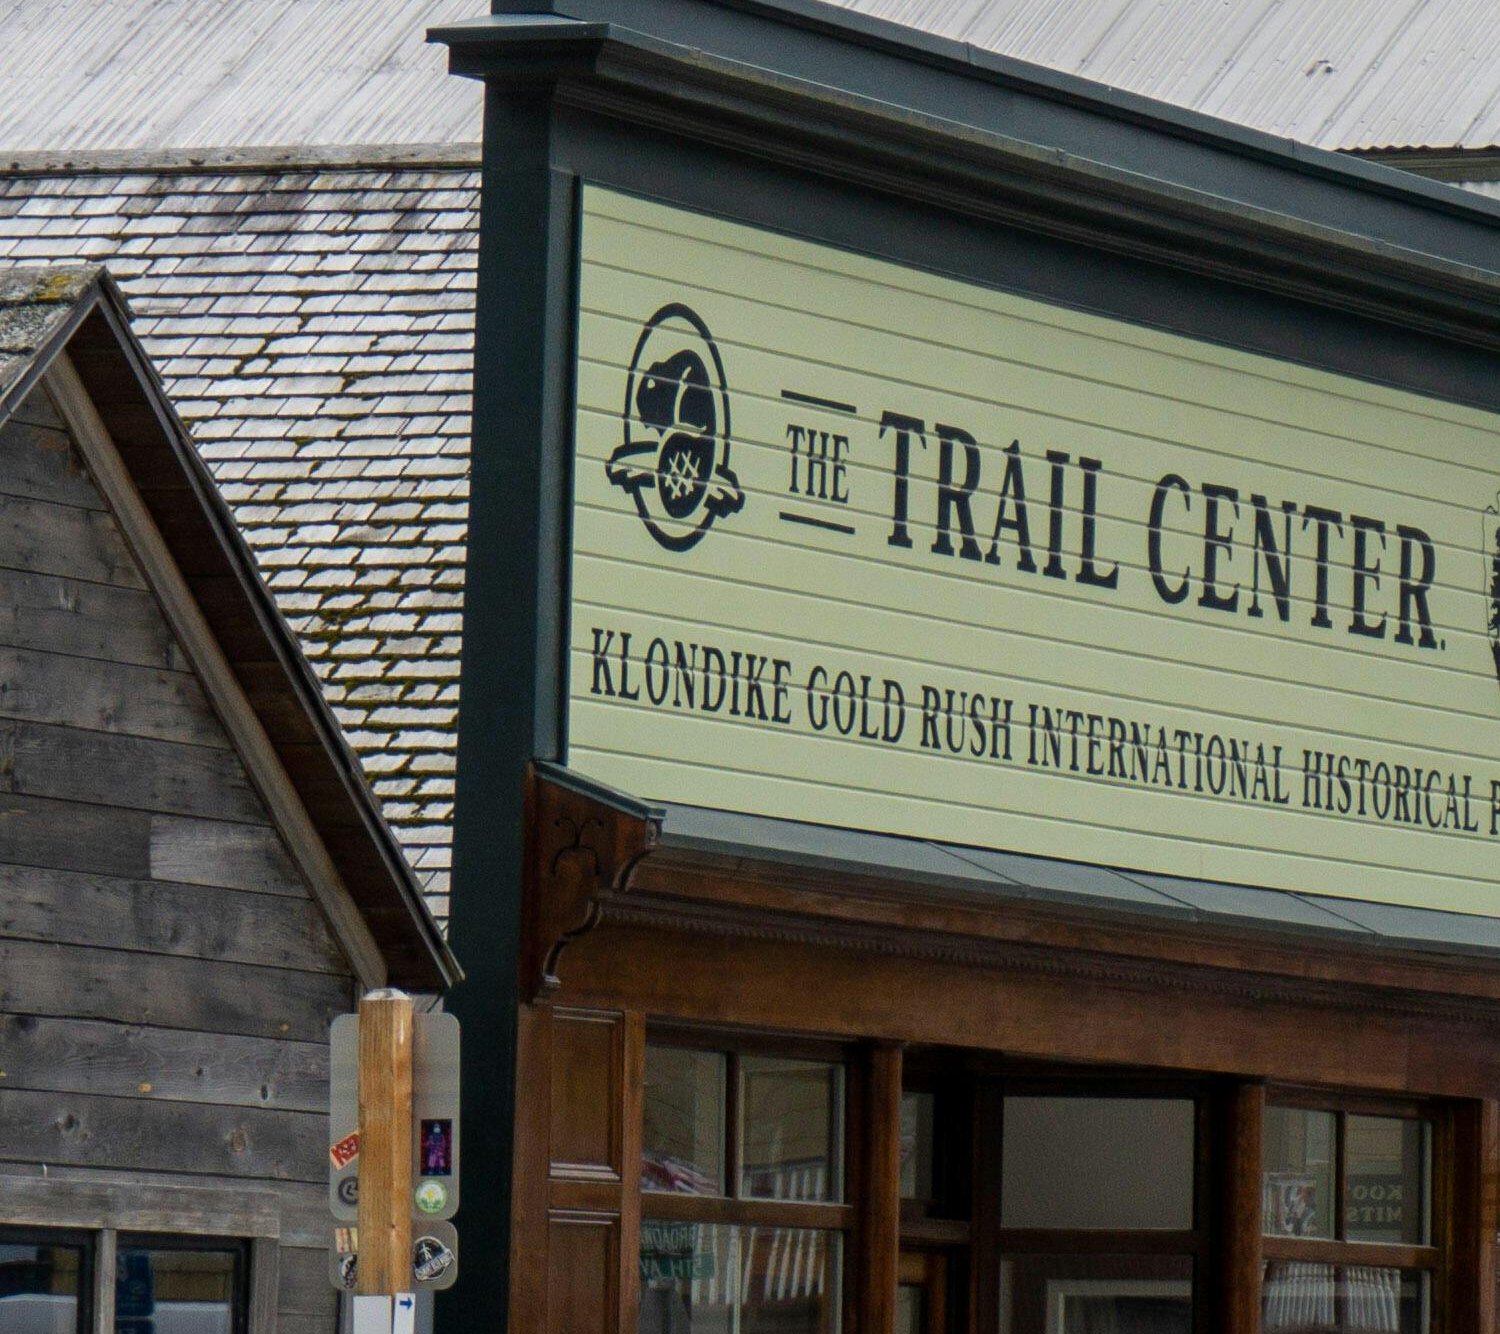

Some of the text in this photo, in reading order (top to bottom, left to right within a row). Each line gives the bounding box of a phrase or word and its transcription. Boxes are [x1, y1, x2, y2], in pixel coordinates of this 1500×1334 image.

[785, 424, 849, 504] THE
[879, 410, 1120, 591] TRAIL
[590, 628, 793, 727] KLONDIKE
[805, 666, 905, 749] GOLD
[919, 684, 1015, 761] RUSH
[1027, 707, 1290, 807] INTERNATIONAL
[1301, 749, 1480, 833] HISTORICAL
